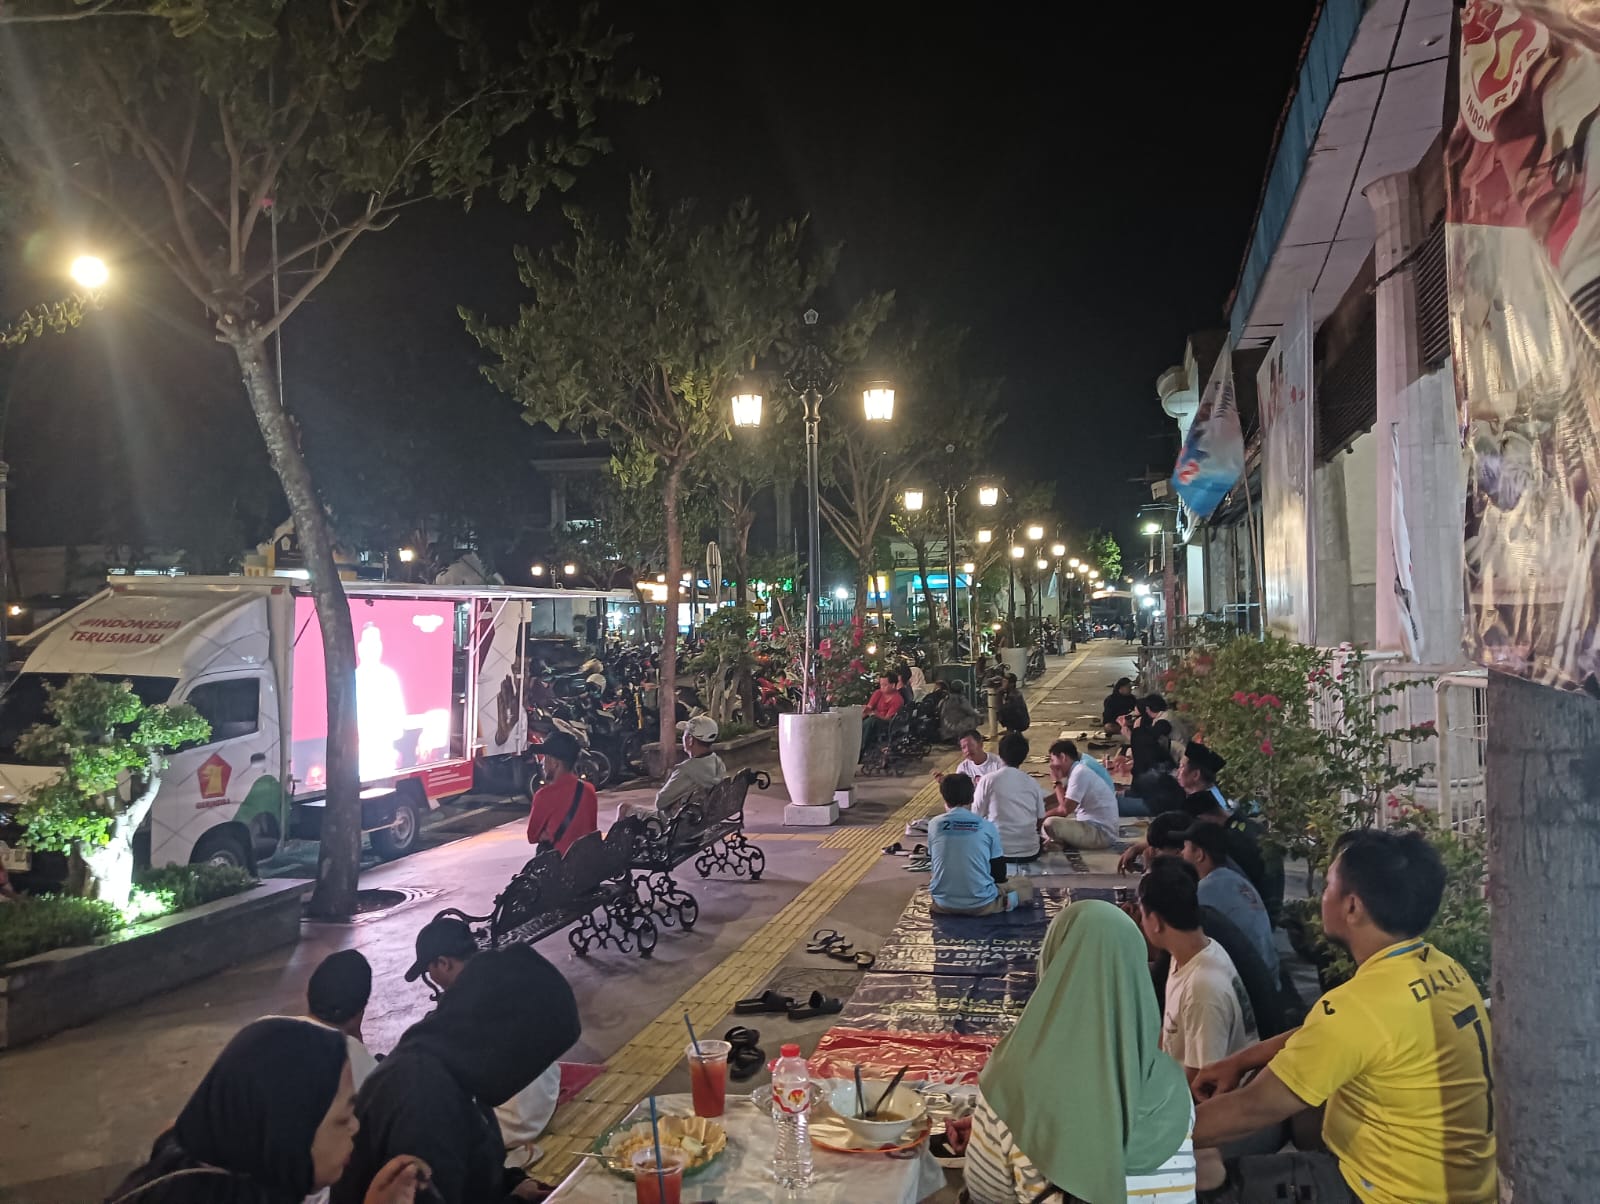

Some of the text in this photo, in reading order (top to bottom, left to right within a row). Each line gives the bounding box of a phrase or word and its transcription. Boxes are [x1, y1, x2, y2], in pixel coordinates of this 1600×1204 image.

[69, 630, 165, 644] TERUSMAJU
[943, 820, 951, 830] 2
[991, 938, 1034, 946] DAN
[1452, 1004, 1494, 1134] 7
